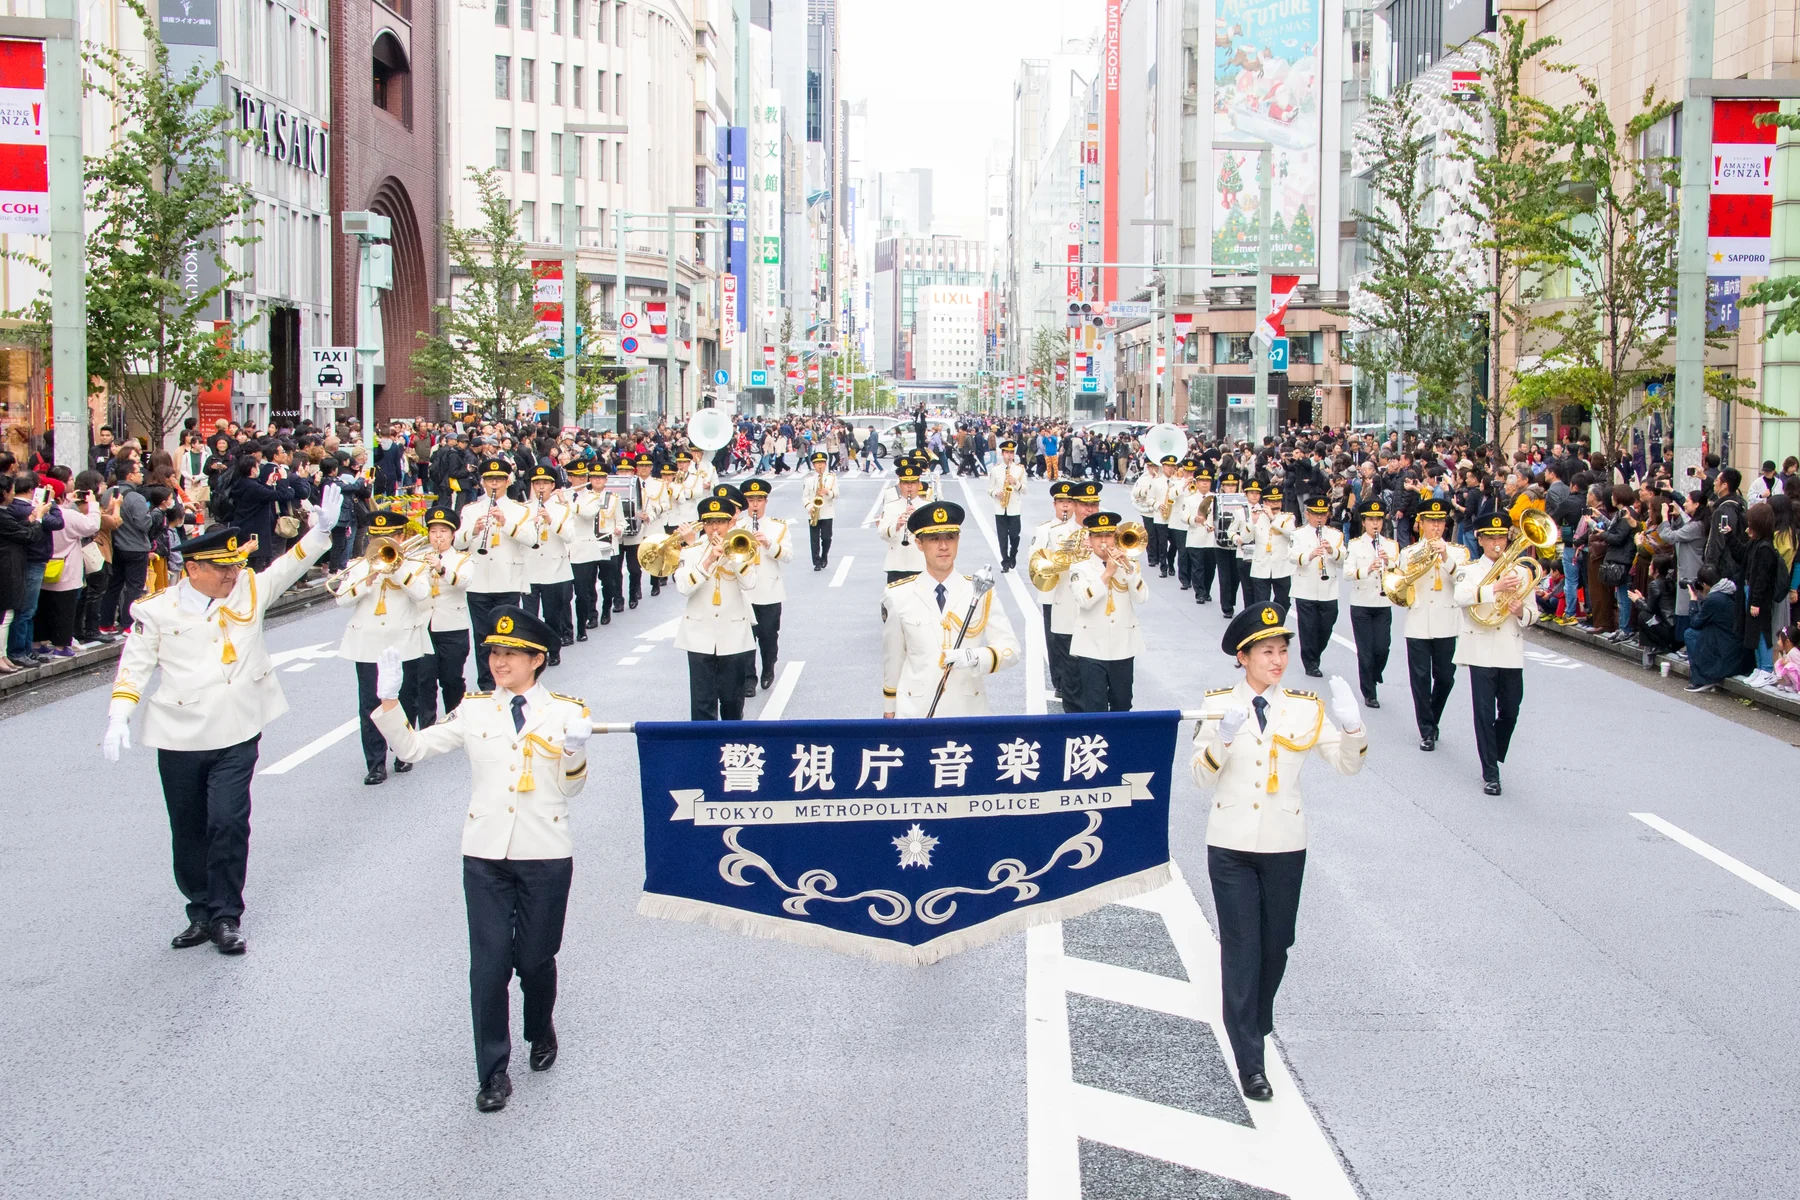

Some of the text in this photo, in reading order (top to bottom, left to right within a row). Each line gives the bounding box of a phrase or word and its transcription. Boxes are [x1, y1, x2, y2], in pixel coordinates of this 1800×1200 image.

[1108, 5, 1119, 91] MITSUKOSHI
[238, 92, 329, 178] TASAKI
[764, 106, 778, 192] 教文館
[764, 240, 778, 261] 本
[1728, 253, 1765, 263] SAPPORO
[933, 292, 972, 304] LIXIL
[725, 295, 735, 344] キムラヤのパン
[313, 351, 348, 362] TAXI
[720, 734, 1110, 792] 警視庁音楽隊
[706, 790, 1113, 820] TOKYO METROPOLITAN POLICE BAND
